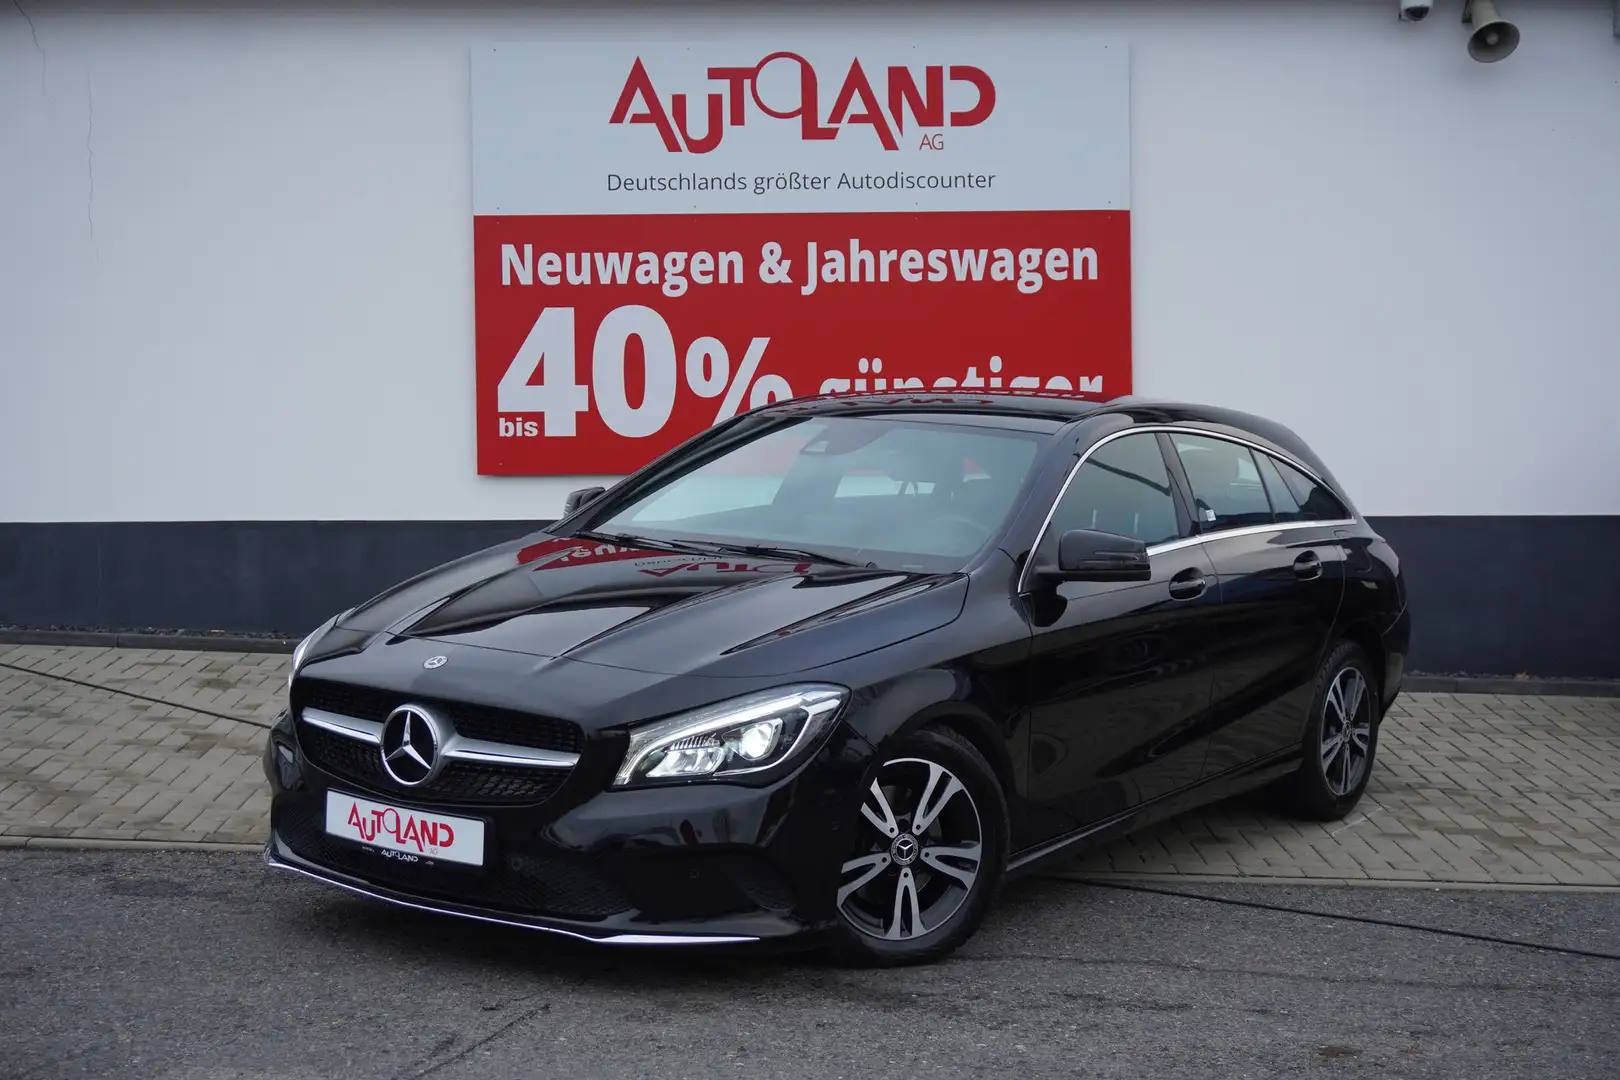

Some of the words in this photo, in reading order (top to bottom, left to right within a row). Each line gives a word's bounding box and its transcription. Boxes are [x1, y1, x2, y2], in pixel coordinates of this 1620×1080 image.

[609, 52, 996, 154] AUTOLAND
[919, 133, 945, 151] AG
[606, 173, 748, 191] Deutschlands
[753, 171, 832, 195] größter
[837, 171, 996, 190] Autodiscounter
[501, 243, 744, 298] Neuwagen
[758, 241, 793, 284] &
[801, 238, 1099, 296] Jahreswagen
[497, 304, 794, 438] 40%
[499, 417, 539, 438] bis
[348, 802, 454, 852] AUTOLAND
